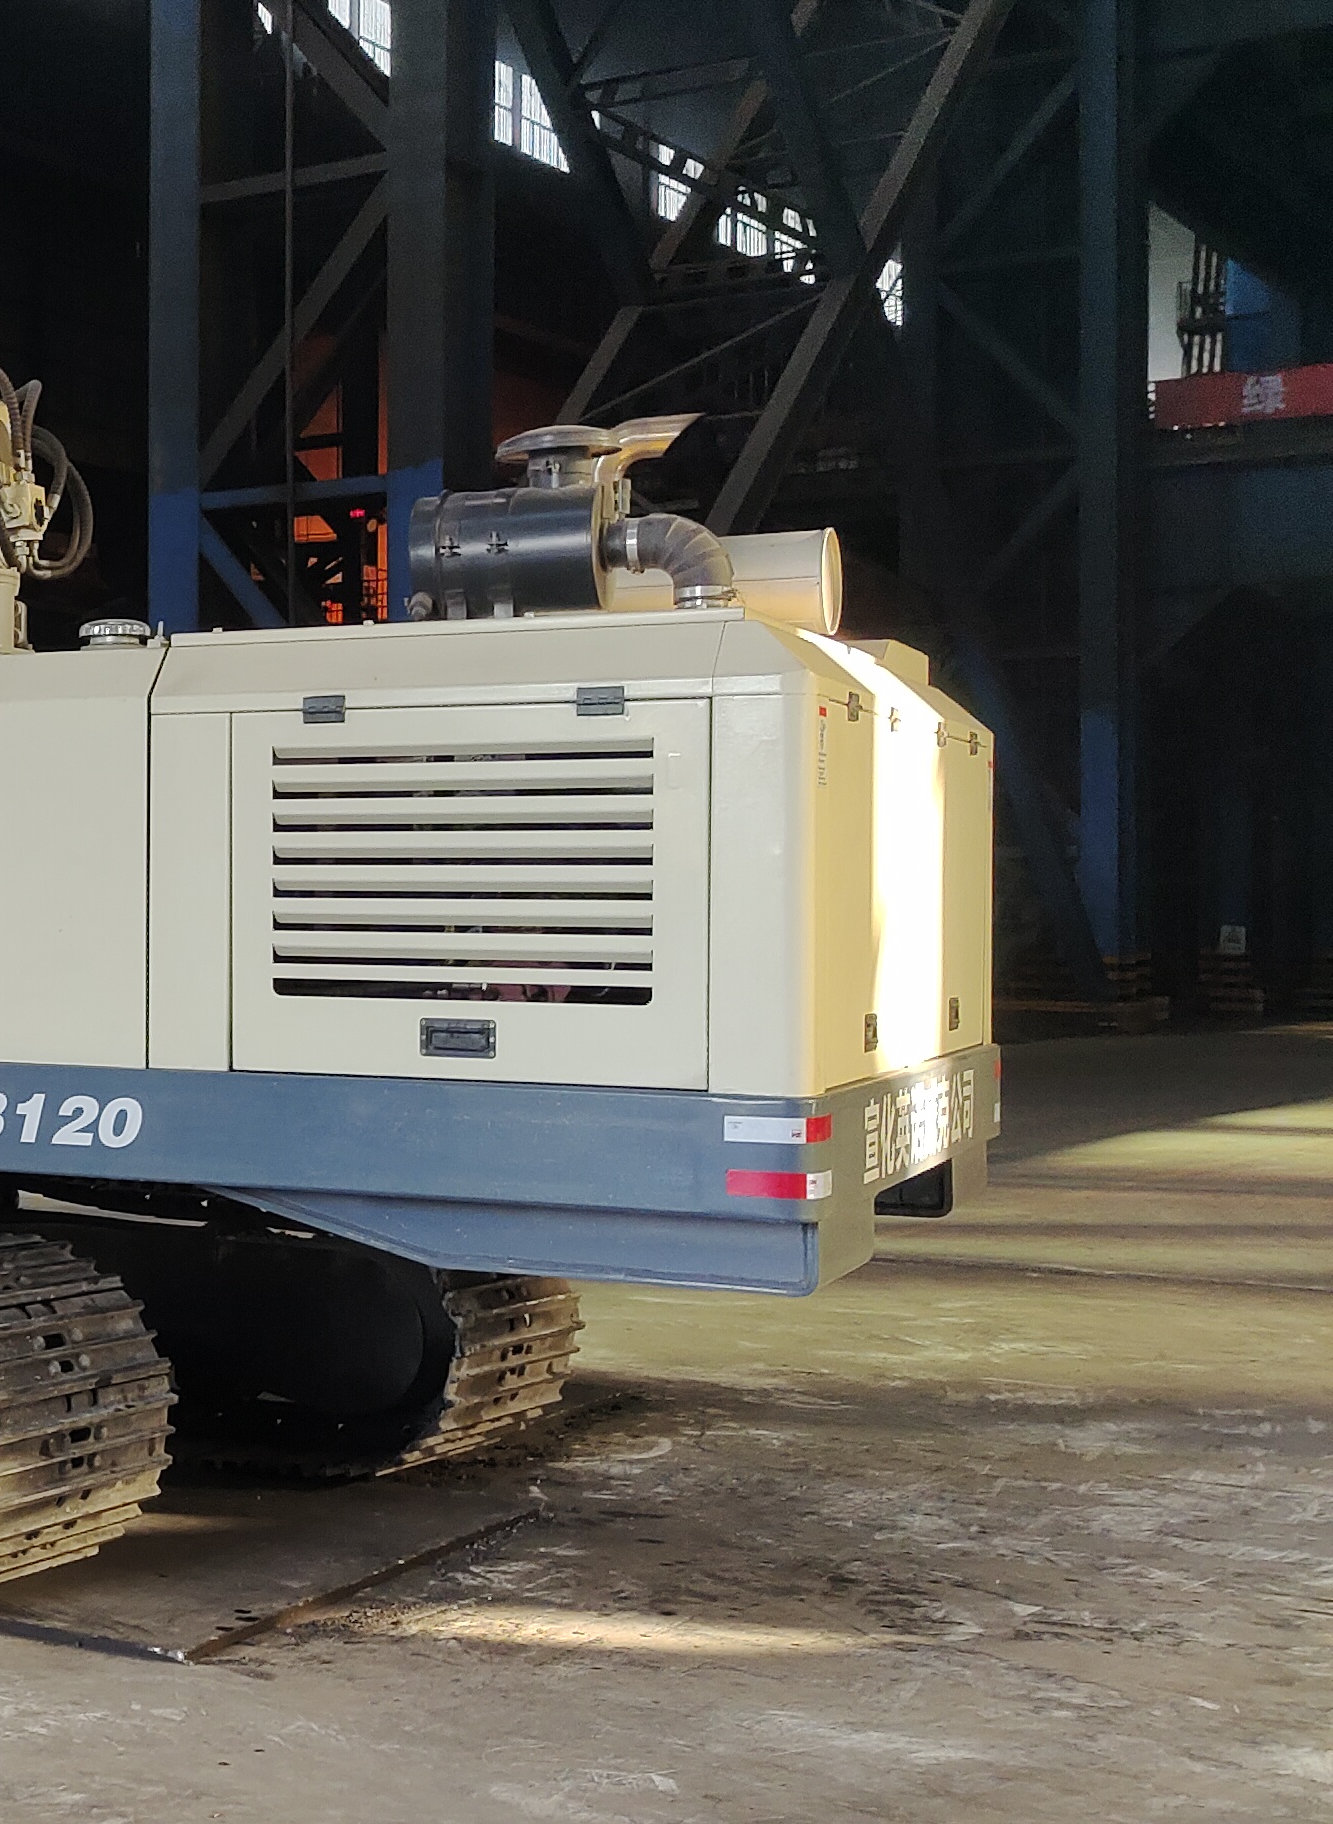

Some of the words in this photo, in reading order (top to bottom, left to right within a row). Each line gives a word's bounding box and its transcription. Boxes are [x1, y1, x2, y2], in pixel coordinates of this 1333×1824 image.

[863, 1069, 975, 1185] 宣化英克公司
